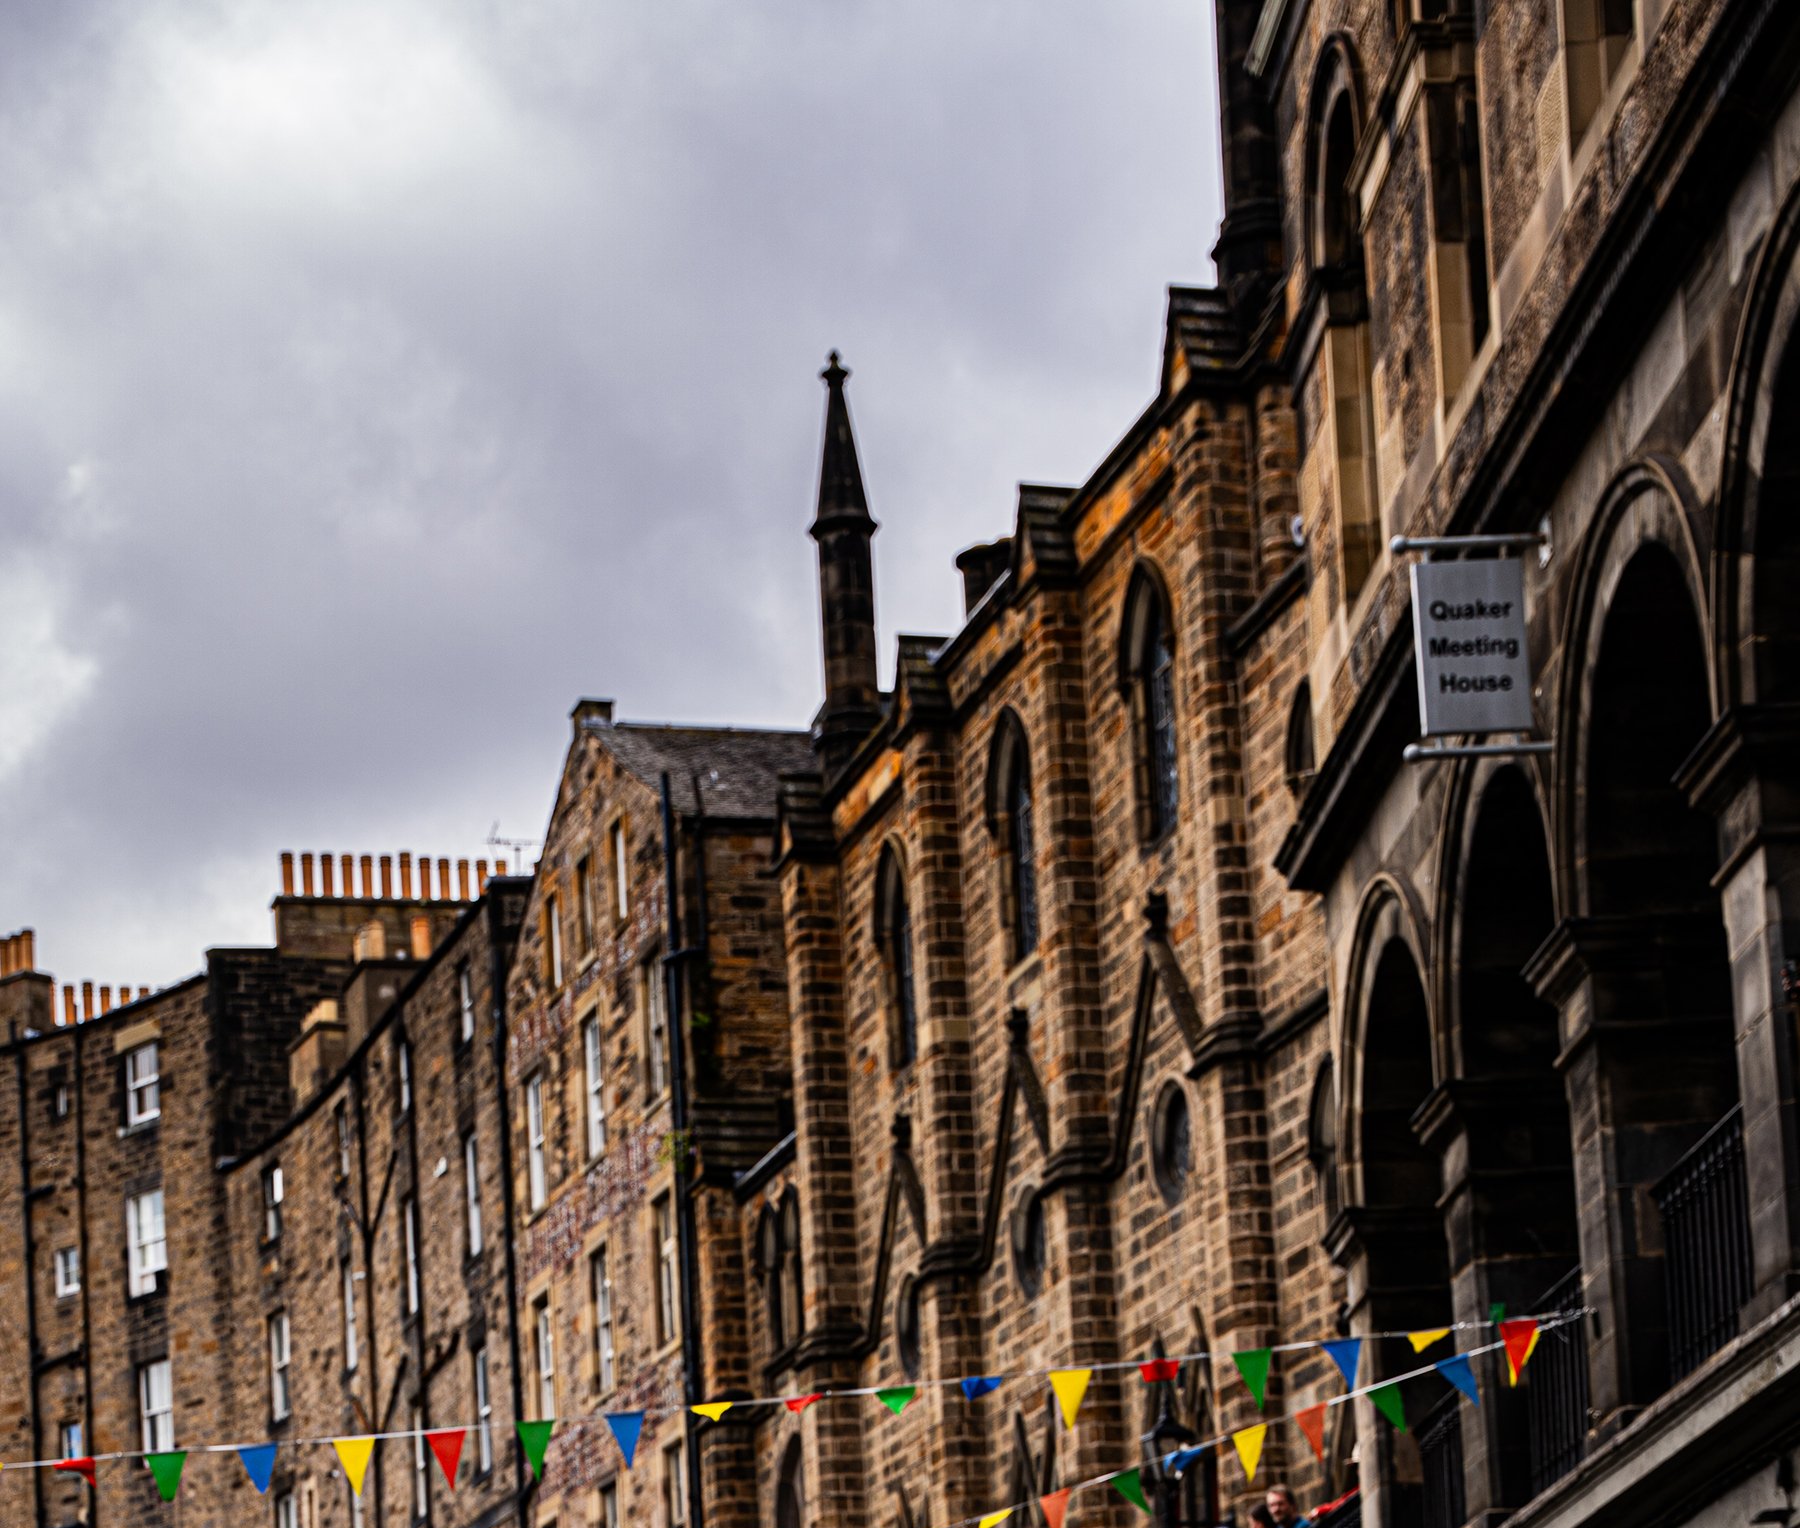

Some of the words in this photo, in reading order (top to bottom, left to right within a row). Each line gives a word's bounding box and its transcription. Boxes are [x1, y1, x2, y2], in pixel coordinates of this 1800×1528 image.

[1430, 600, 1513, 621] Quaker
[1429, 636, 1519, 659] Meeting
[1440, 673, 1513, 694] House
